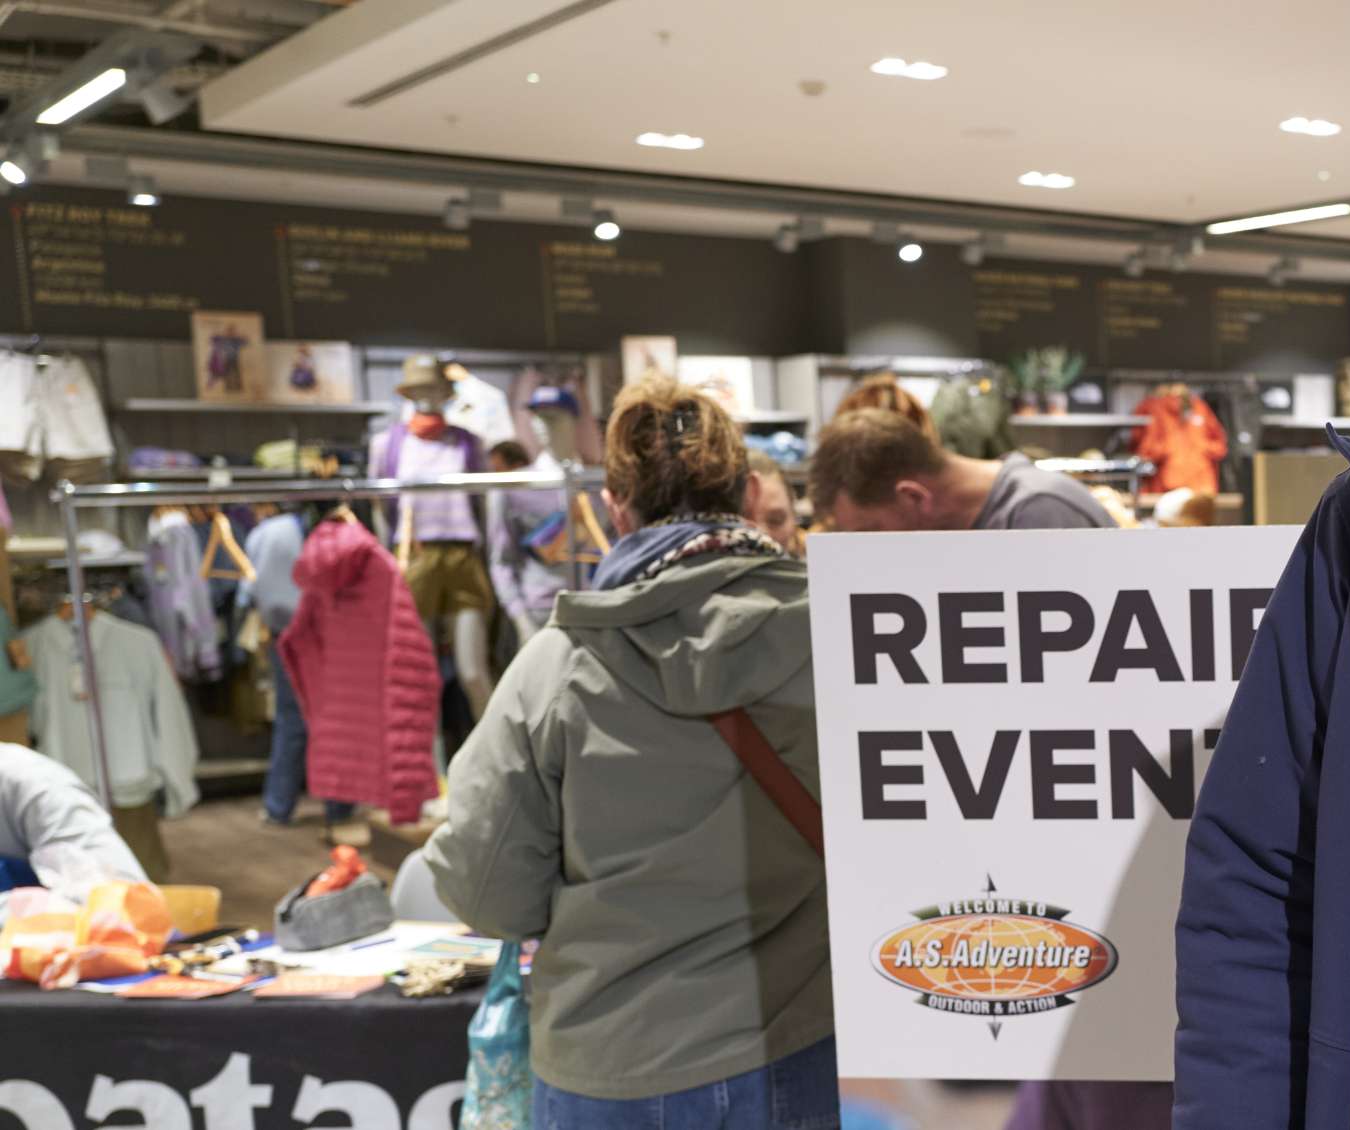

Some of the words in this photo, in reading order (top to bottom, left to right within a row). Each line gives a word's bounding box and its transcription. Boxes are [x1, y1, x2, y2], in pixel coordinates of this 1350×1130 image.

[857, 729, 1221, 820] EVEN
[939, 900, 1021, 916] WELCOME
[1027, 903, 1047, 916] TO
[895, 939, 1091, 969] A.S.Adventure
[928, 995, 990, 1014] OUTDOOR
[994, 1002, 1004, 1014] &
[1008, 996, 1057, 1014] ACTION
